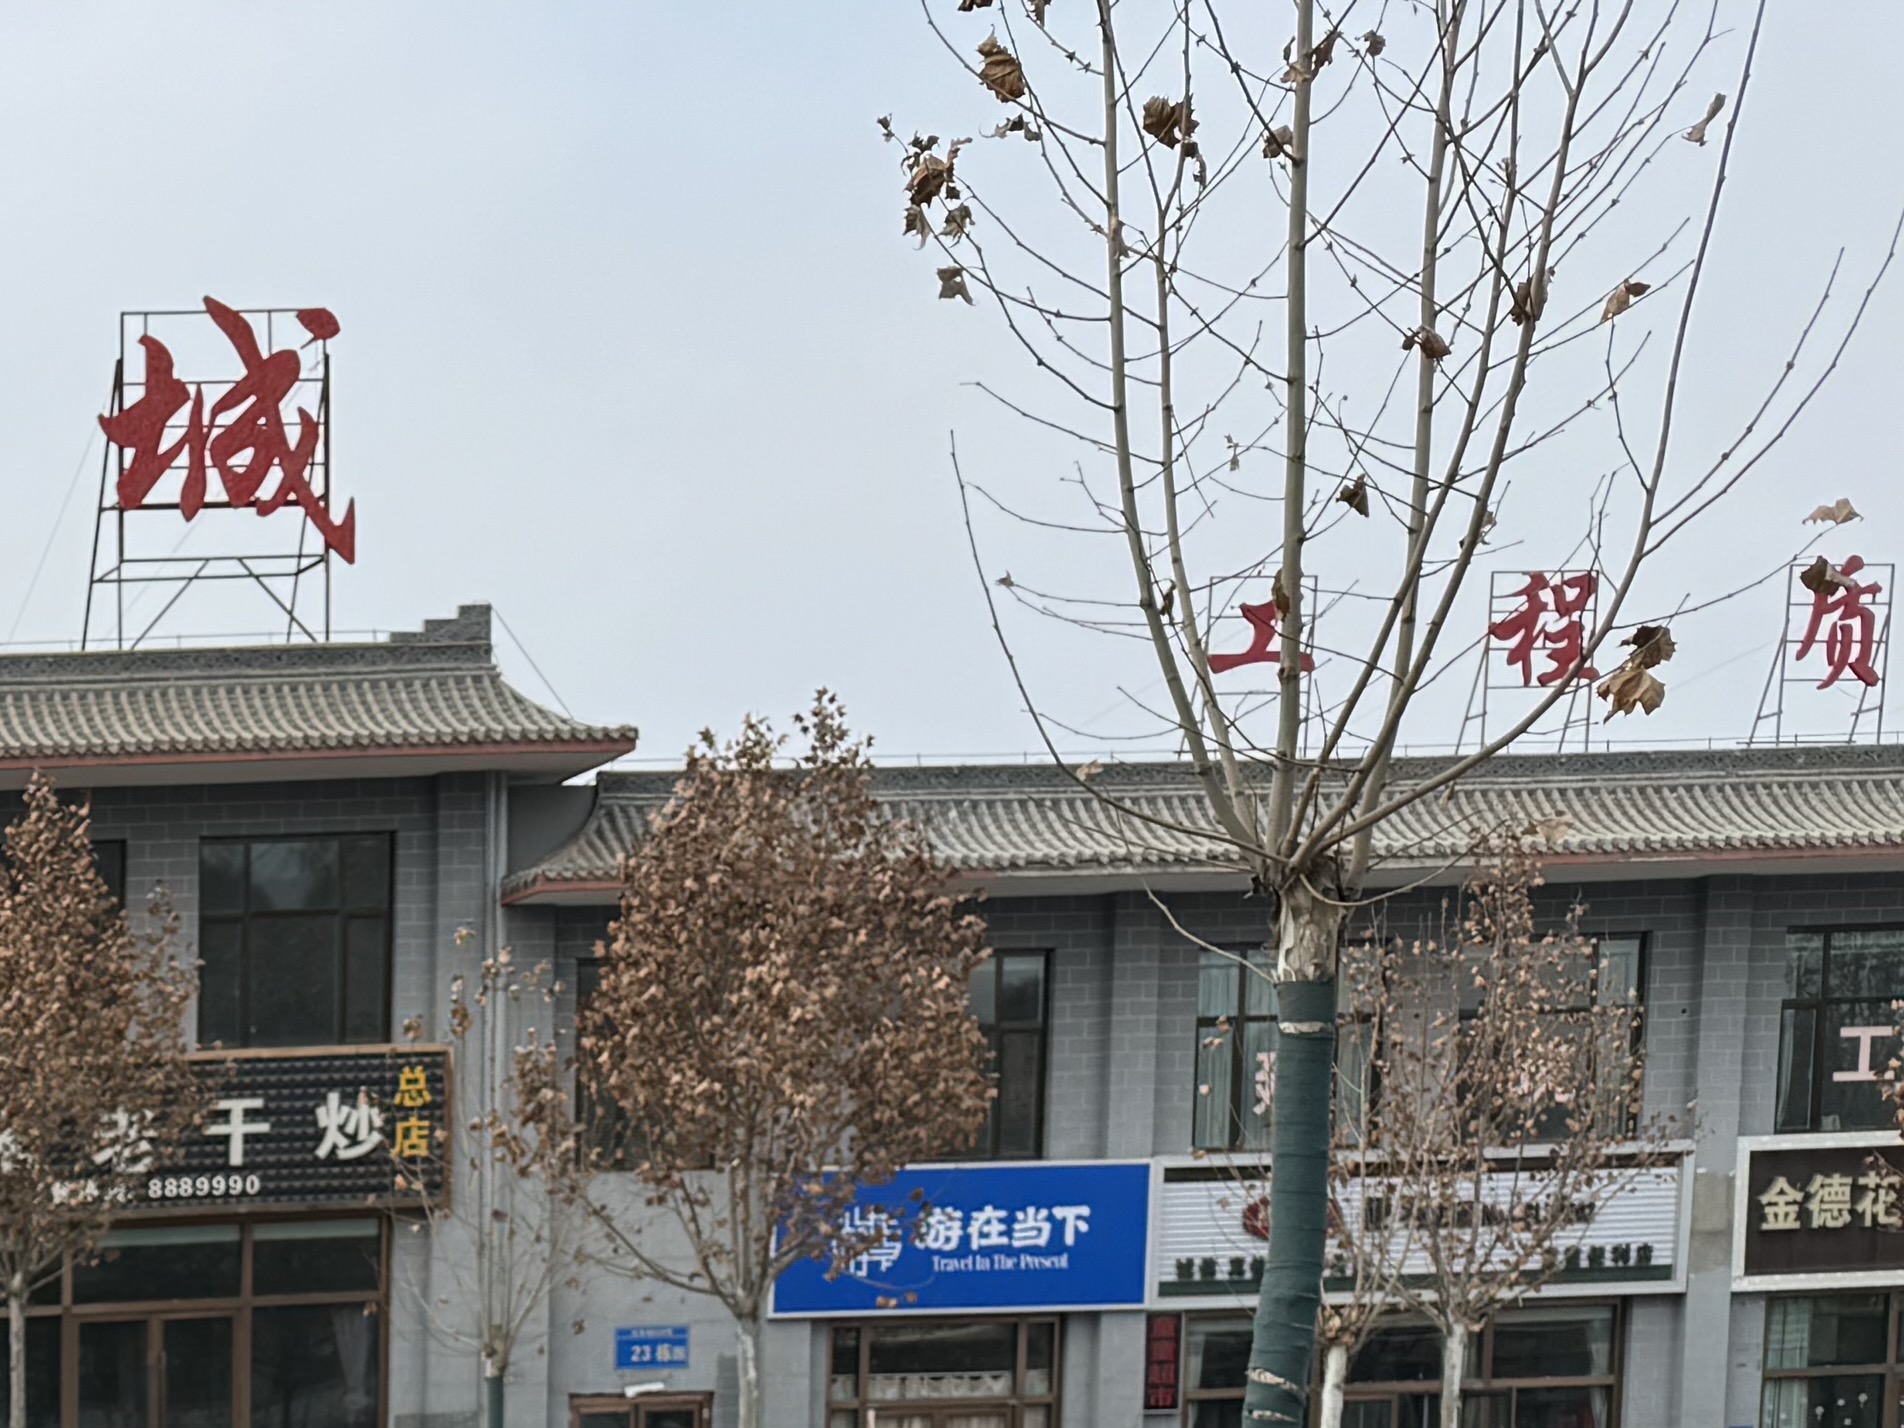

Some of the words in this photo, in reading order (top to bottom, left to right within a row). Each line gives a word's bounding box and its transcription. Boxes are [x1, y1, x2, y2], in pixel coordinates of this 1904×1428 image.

[394, 1065, 432, 1159] 总店
[147, 1174, 261, 1199] 8889990
[914, 1204, 1092, 1251] 游在当下
[932, 1253, 973, 1273] Travel
[993, 1252, 1018, 1271] The
[1019, 1251, 1069, 1271] Present
